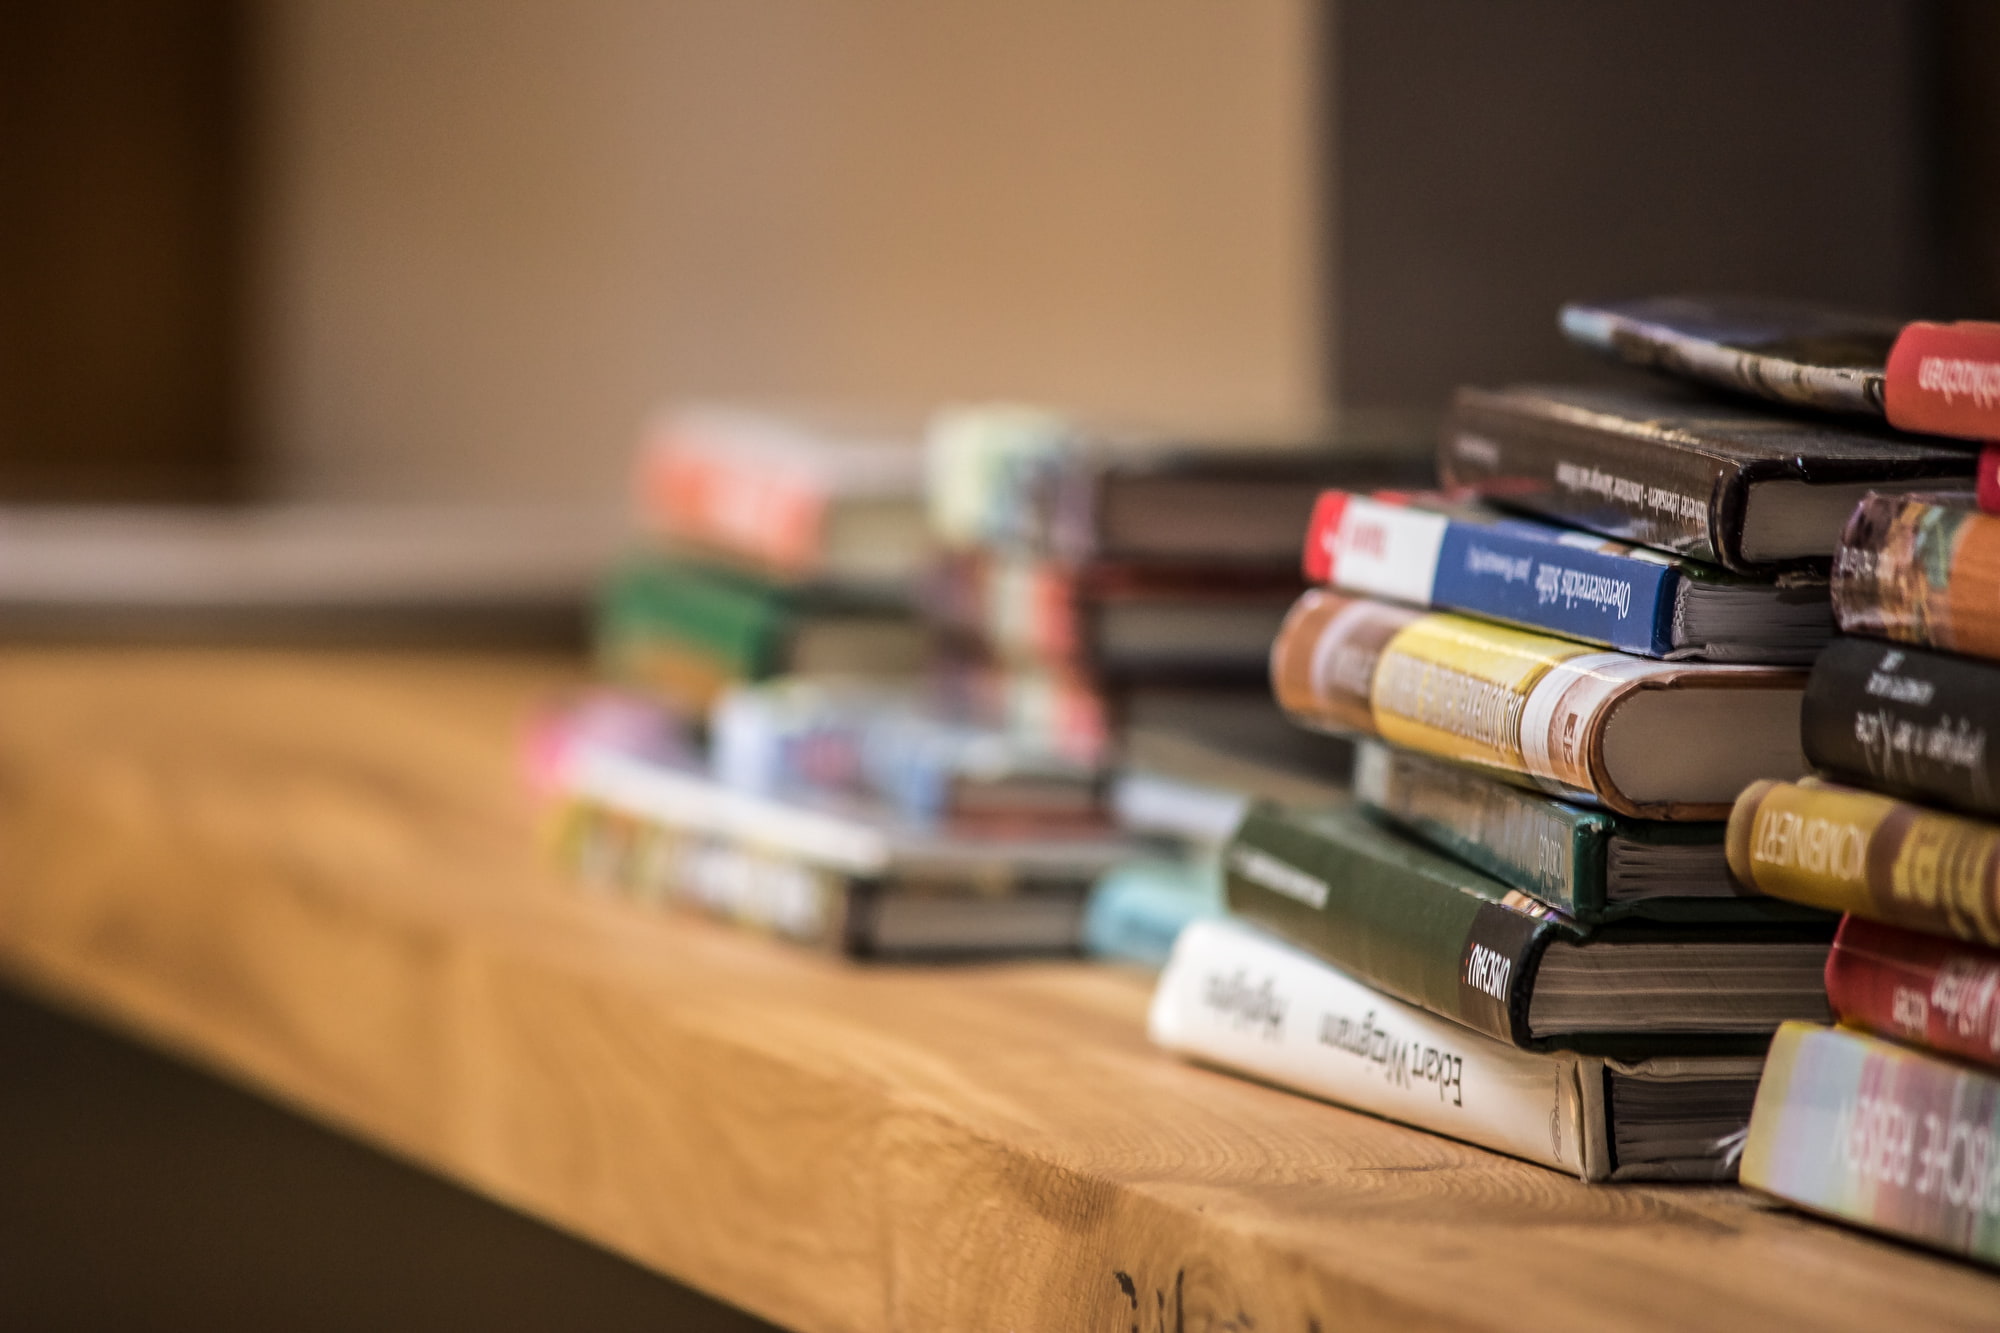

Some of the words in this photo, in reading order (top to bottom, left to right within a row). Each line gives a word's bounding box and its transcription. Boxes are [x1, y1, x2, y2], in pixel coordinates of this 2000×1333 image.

[1561, 567, 1631, 620] Oberösterreichs
[1467, 943, 1510, 1003] UMSCHAU
[1412, 1043, 1463, 1109] Eckart
